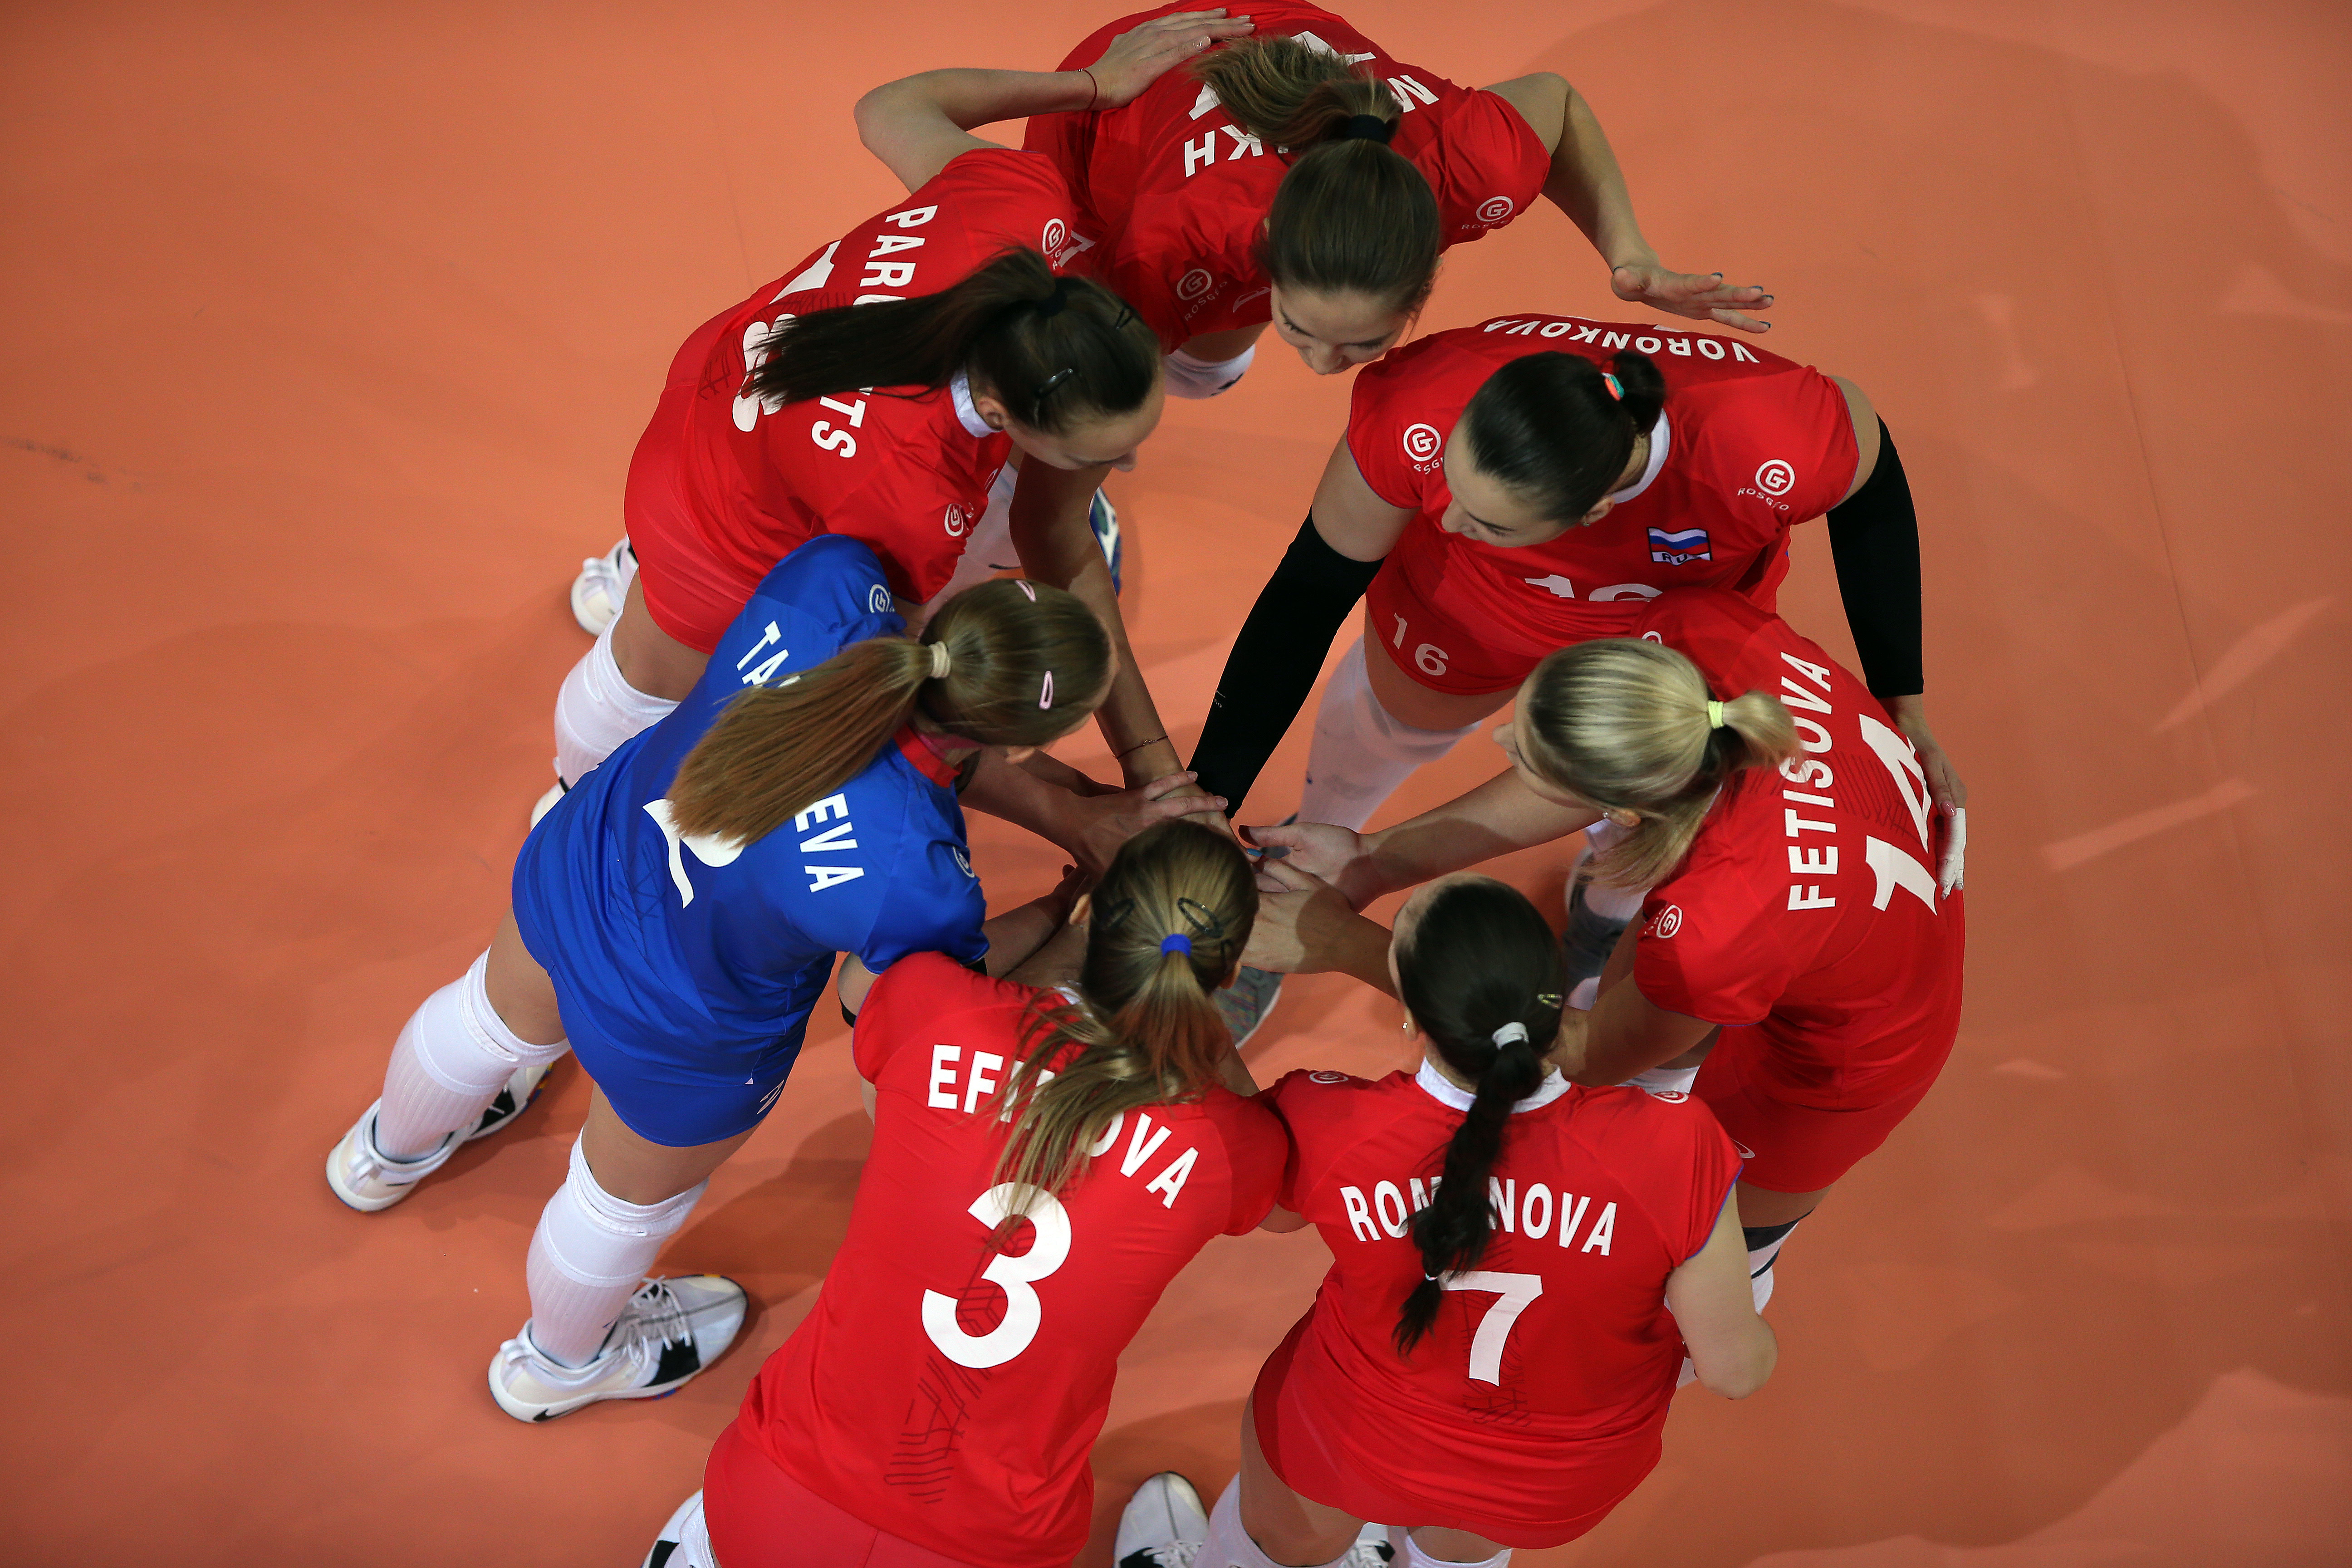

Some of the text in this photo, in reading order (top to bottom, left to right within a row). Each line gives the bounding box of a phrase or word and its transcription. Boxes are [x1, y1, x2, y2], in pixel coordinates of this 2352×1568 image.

[811, 205, 938, 458] PARTS
[1483, 320, 1760, 363] VORONKOVA
[1393, 612, 1449, 676] 16
[1779, 652, 1839, 911] FETISOVA
[1858, 713, 1937, 916] 14
[928, 1044, 1199, 1210] EFIVA
[921, 1181, 1073, 1369] 3
[1340, 1176, 1617, 1256] ROMNOVA
[1437, 1270, 1543, 1387] 7
